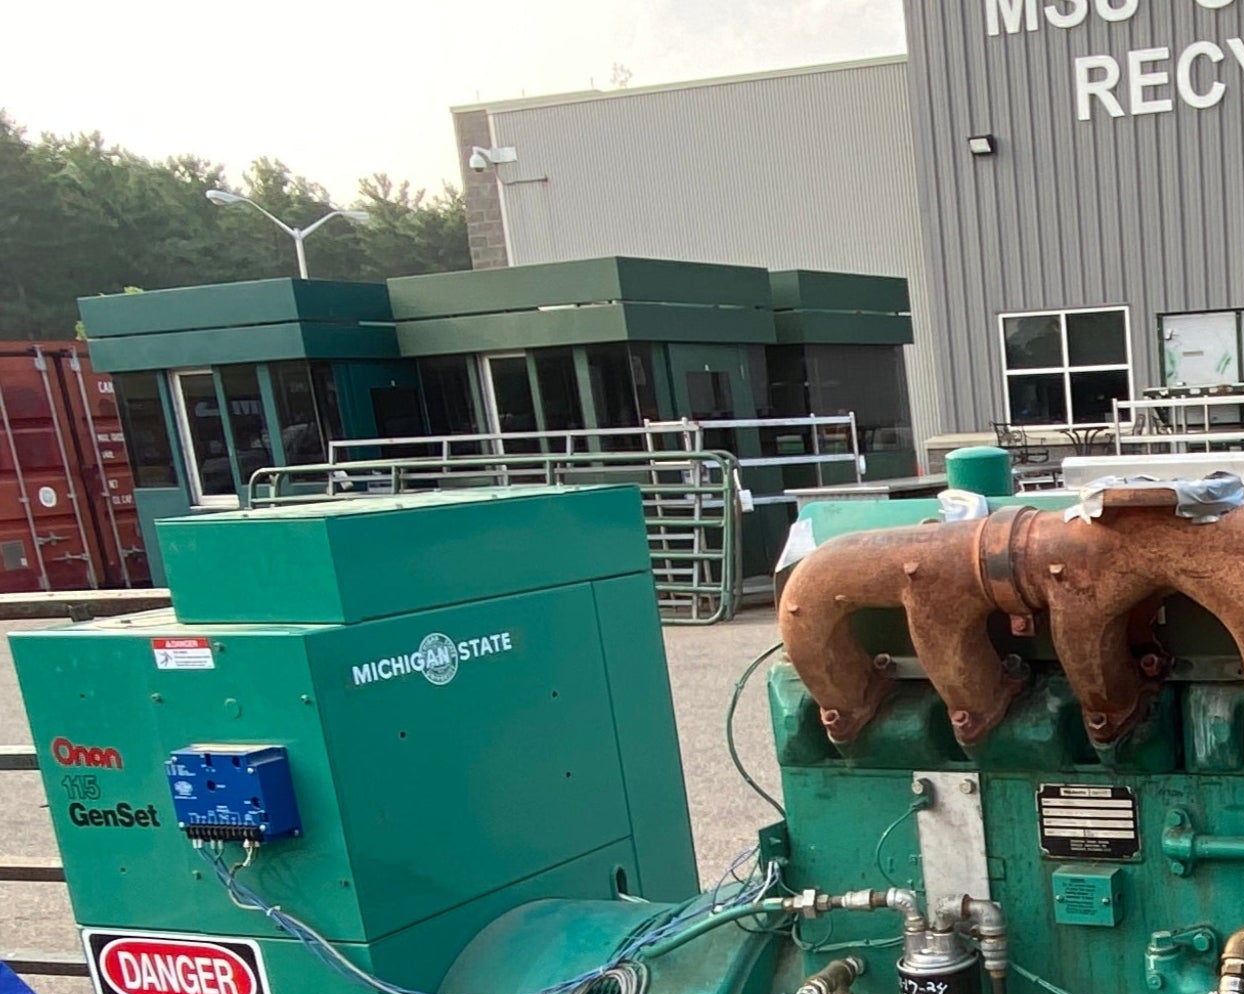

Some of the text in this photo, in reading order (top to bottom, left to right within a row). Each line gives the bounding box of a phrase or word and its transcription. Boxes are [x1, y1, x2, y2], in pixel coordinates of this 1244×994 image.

[352, 646, 450, 685] MICHIGAN
[458, 632, 512, 661] STATE
[52, 737, 123, 769] Onan
[61, 774, 101, 800] 115
[69, 802, 160, 827] GenSet
